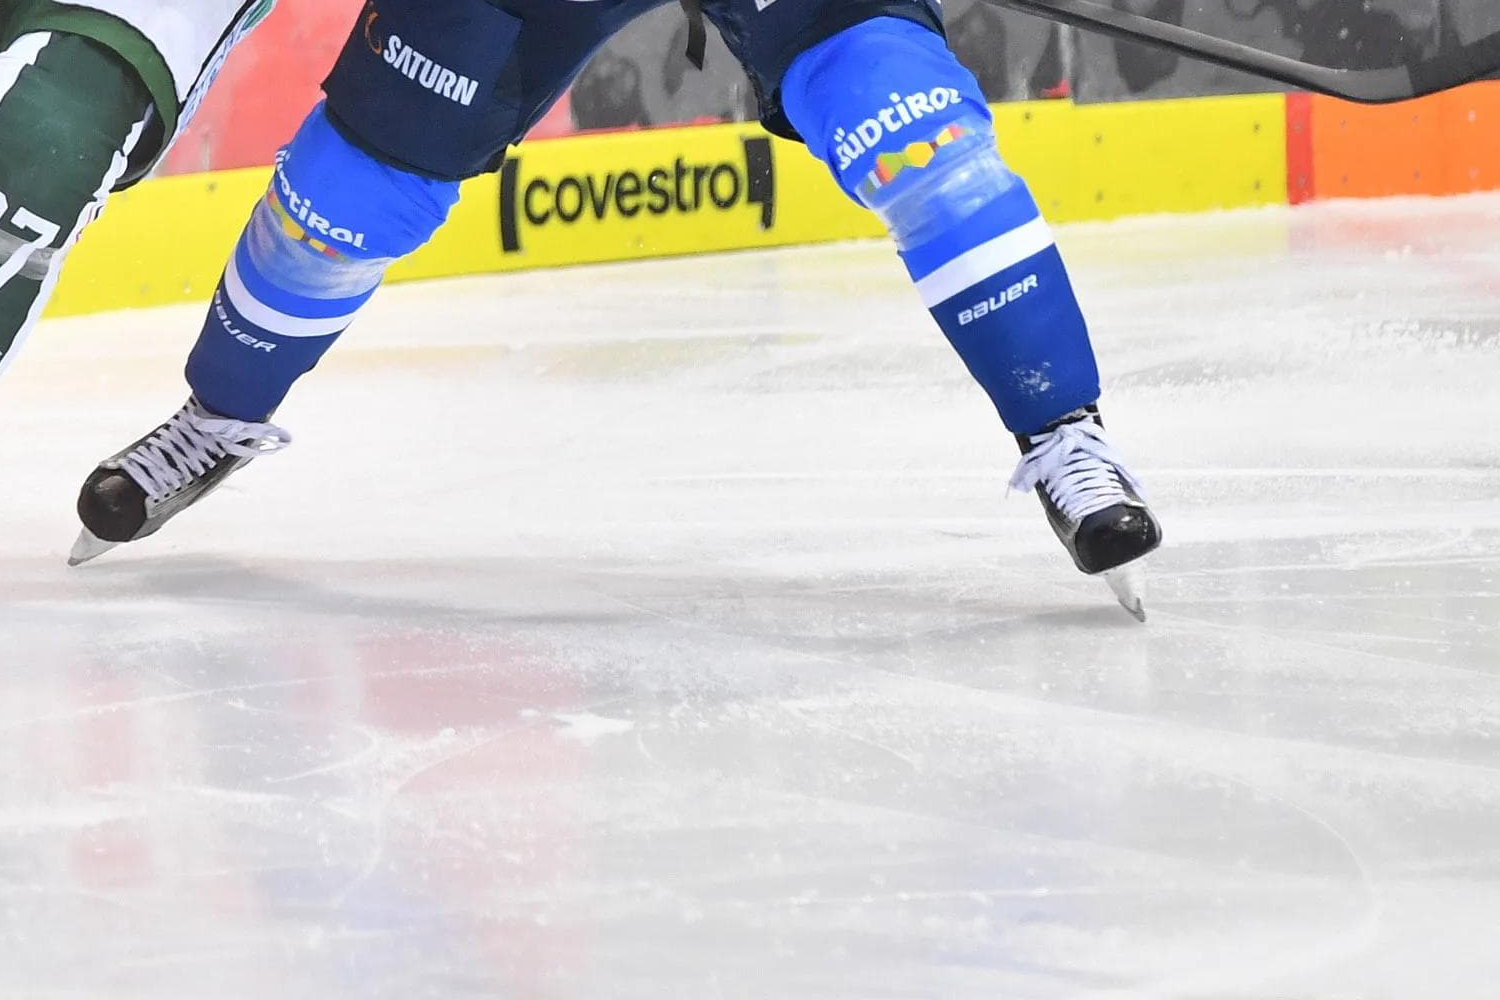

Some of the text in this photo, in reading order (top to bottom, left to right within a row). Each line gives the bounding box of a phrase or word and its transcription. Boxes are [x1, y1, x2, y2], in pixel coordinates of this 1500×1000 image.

[382, 34, 480, 107] SATURN
[521, 157, 743, 228] covestro
[957, 272, 1040, 326] BAUER
